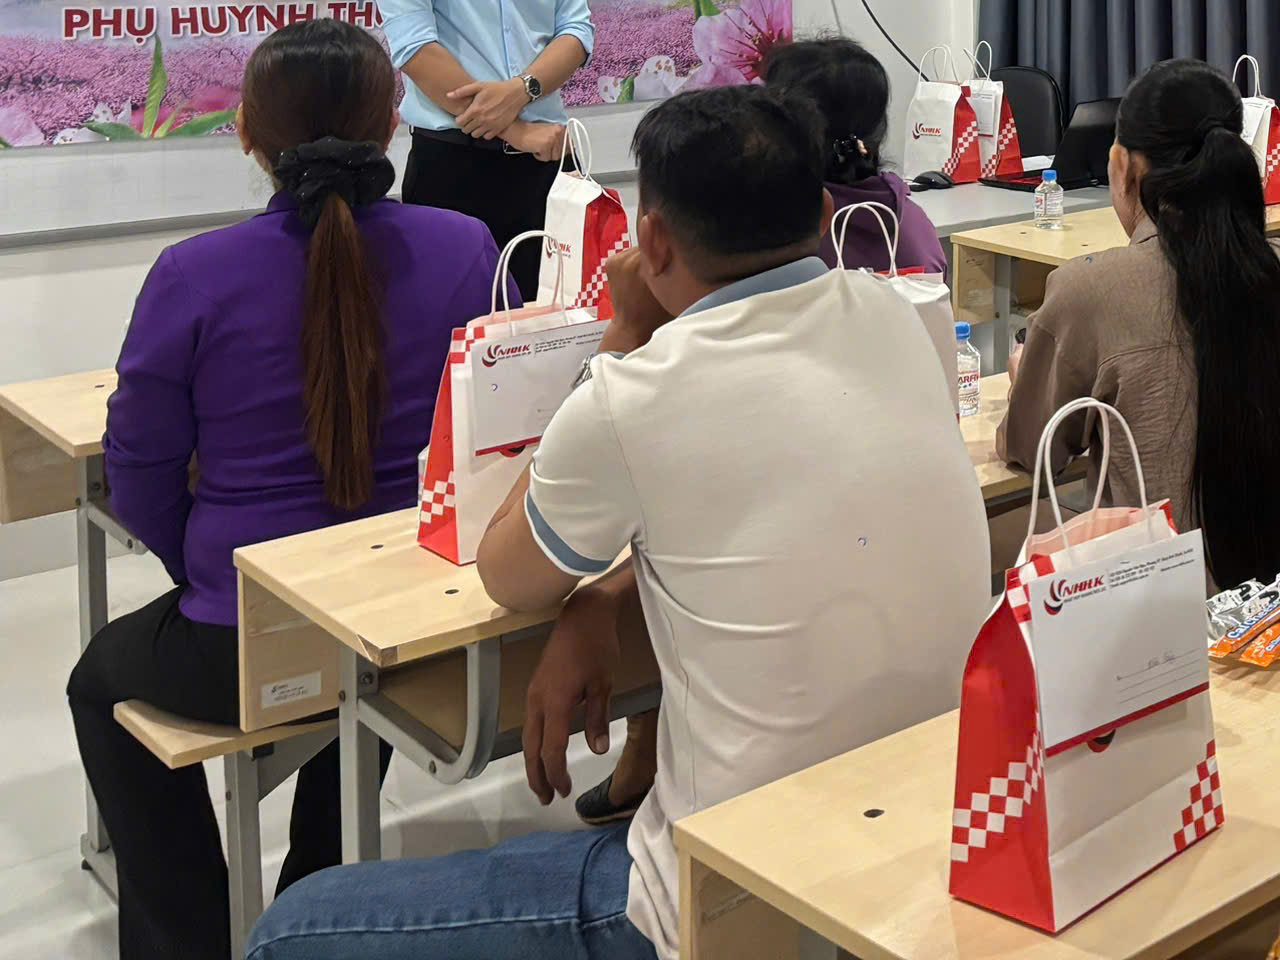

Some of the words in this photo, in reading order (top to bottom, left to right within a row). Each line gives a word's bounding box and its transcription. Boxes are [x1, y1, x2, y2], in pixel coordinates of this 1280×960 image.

[64, 7, 154, 44] PHỤ
[171, 3, 315, 35] HUYNH
[328, 1, 384, 28] TH
